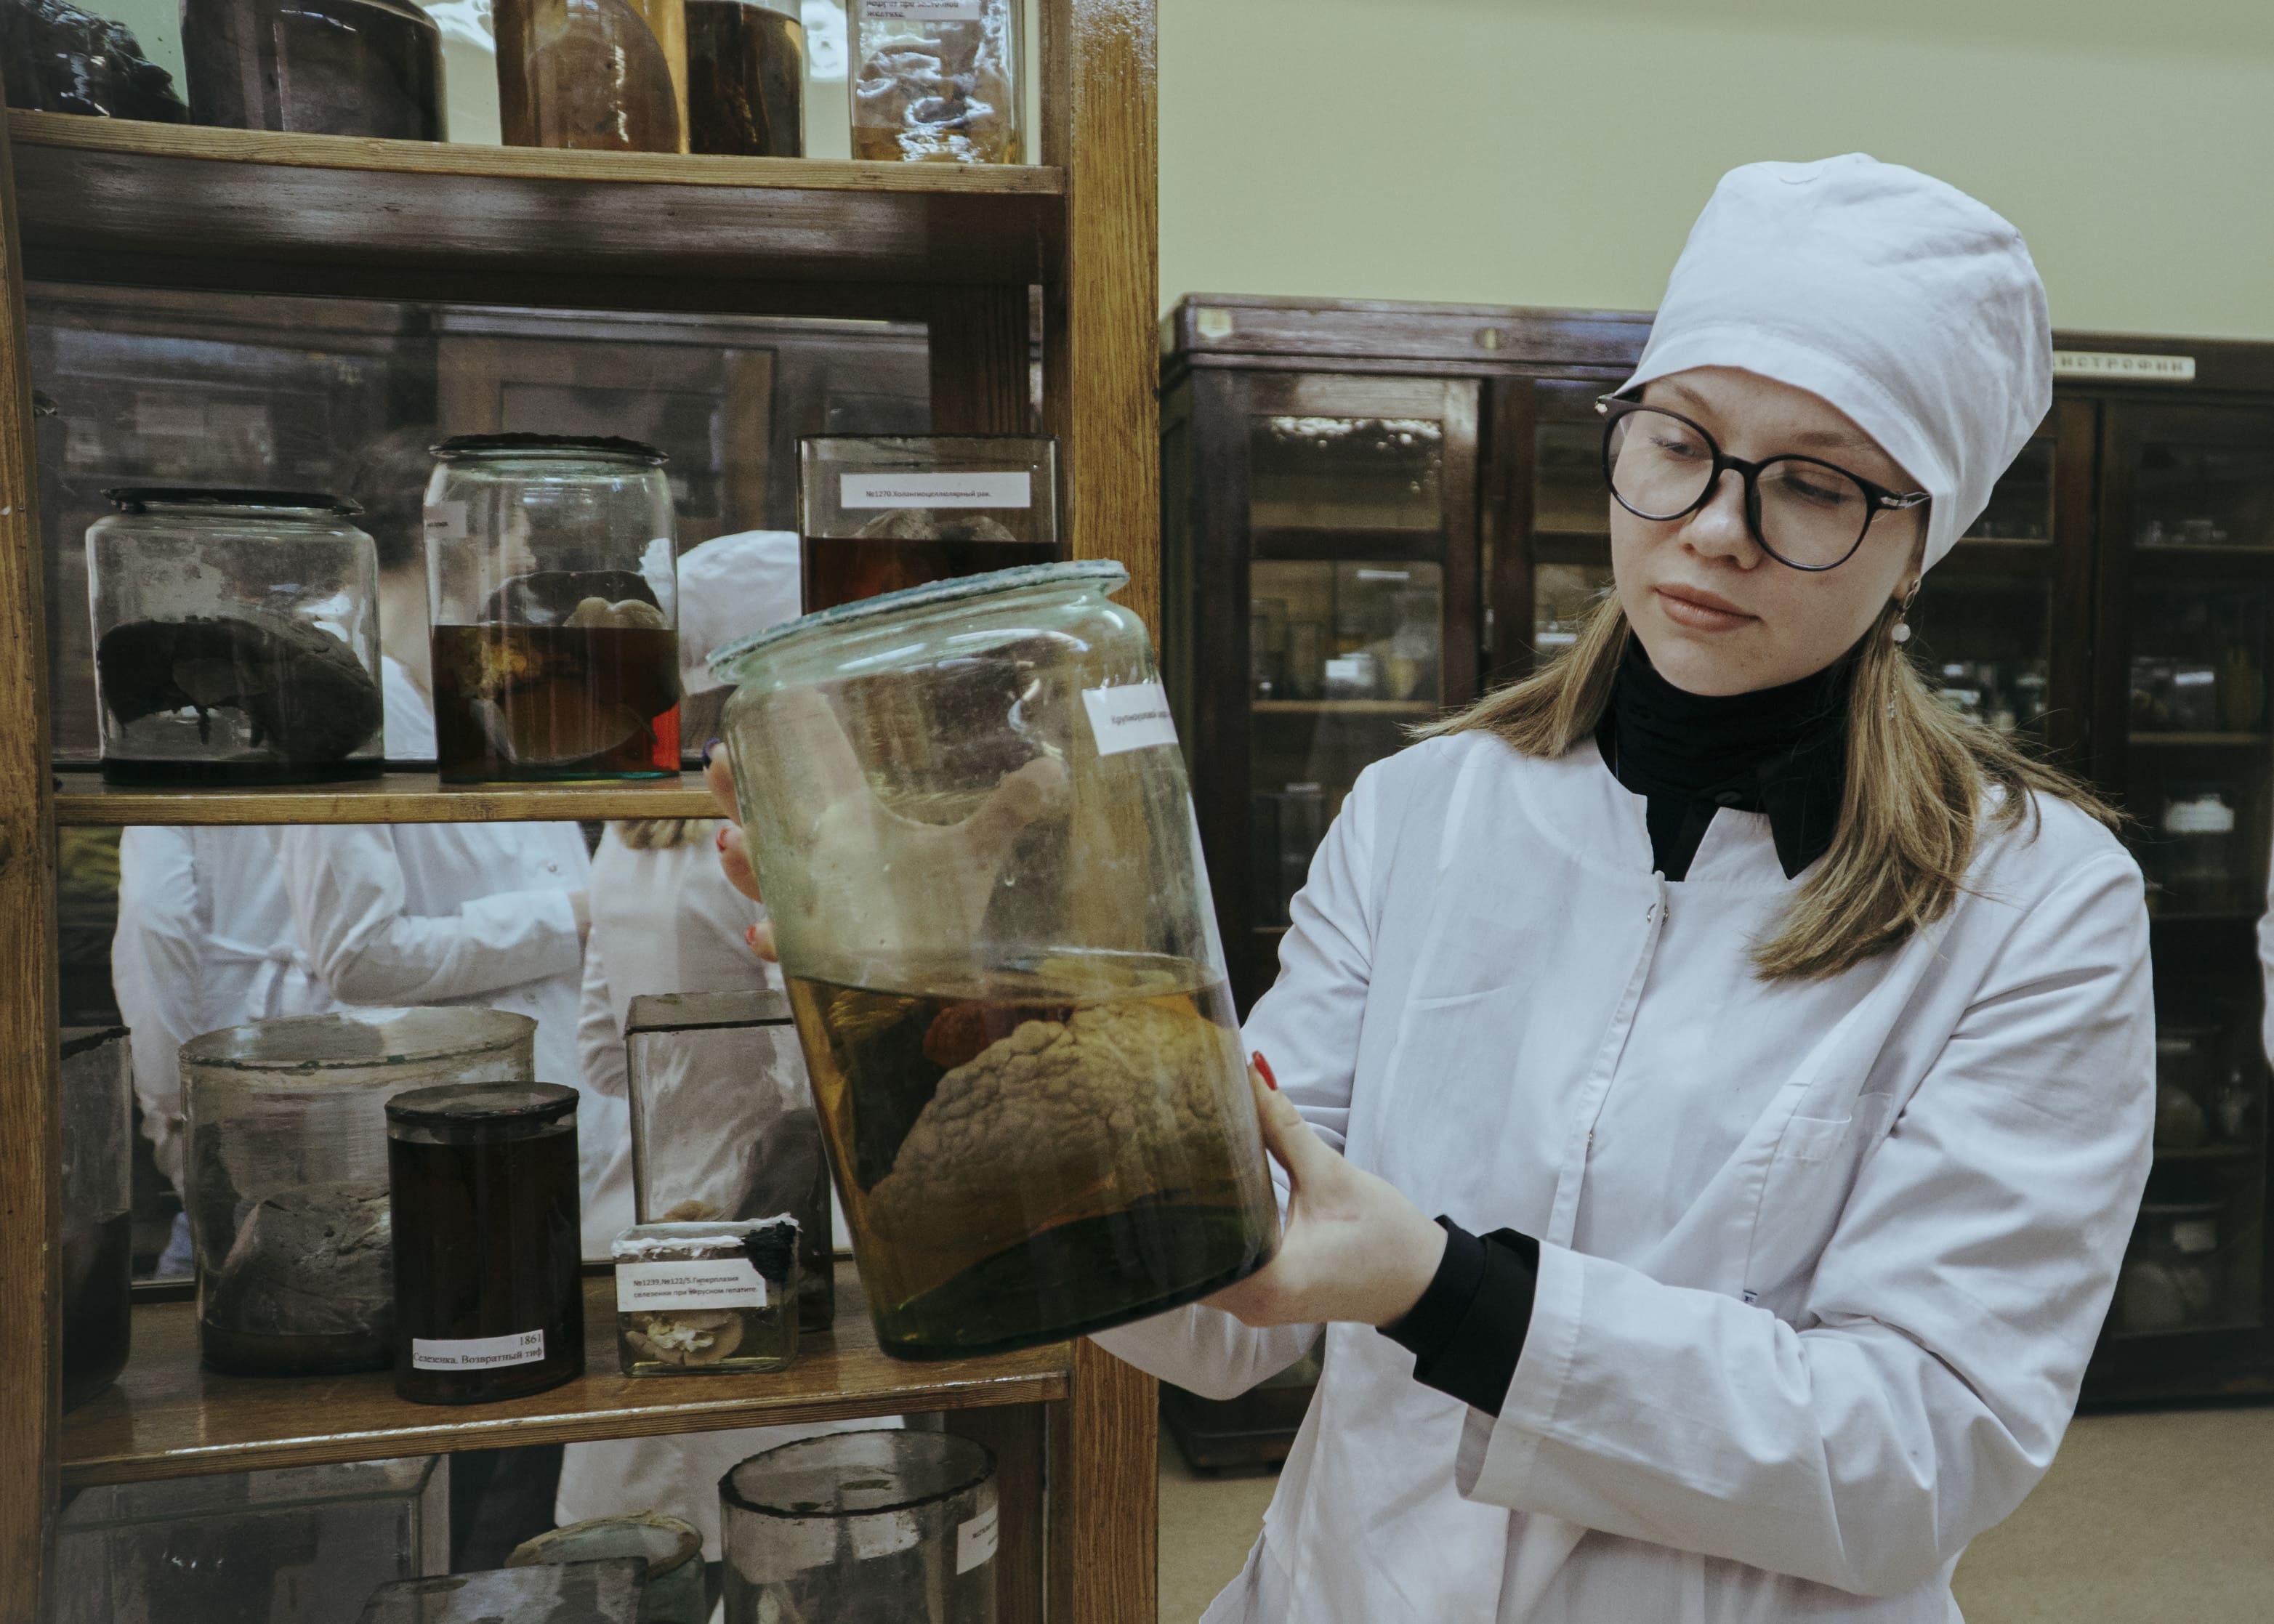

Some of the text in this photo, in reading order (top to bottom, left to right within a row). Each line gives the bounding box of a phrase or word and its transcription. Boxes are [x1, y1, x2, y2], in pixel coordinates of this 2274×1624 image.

[2053, 357, 2183, 372] ИСТРОФИИ
[519, 1333, 542, 1346] 1861
[413, 1347, 543, 1365] Селезенка. Возвратный тиф
